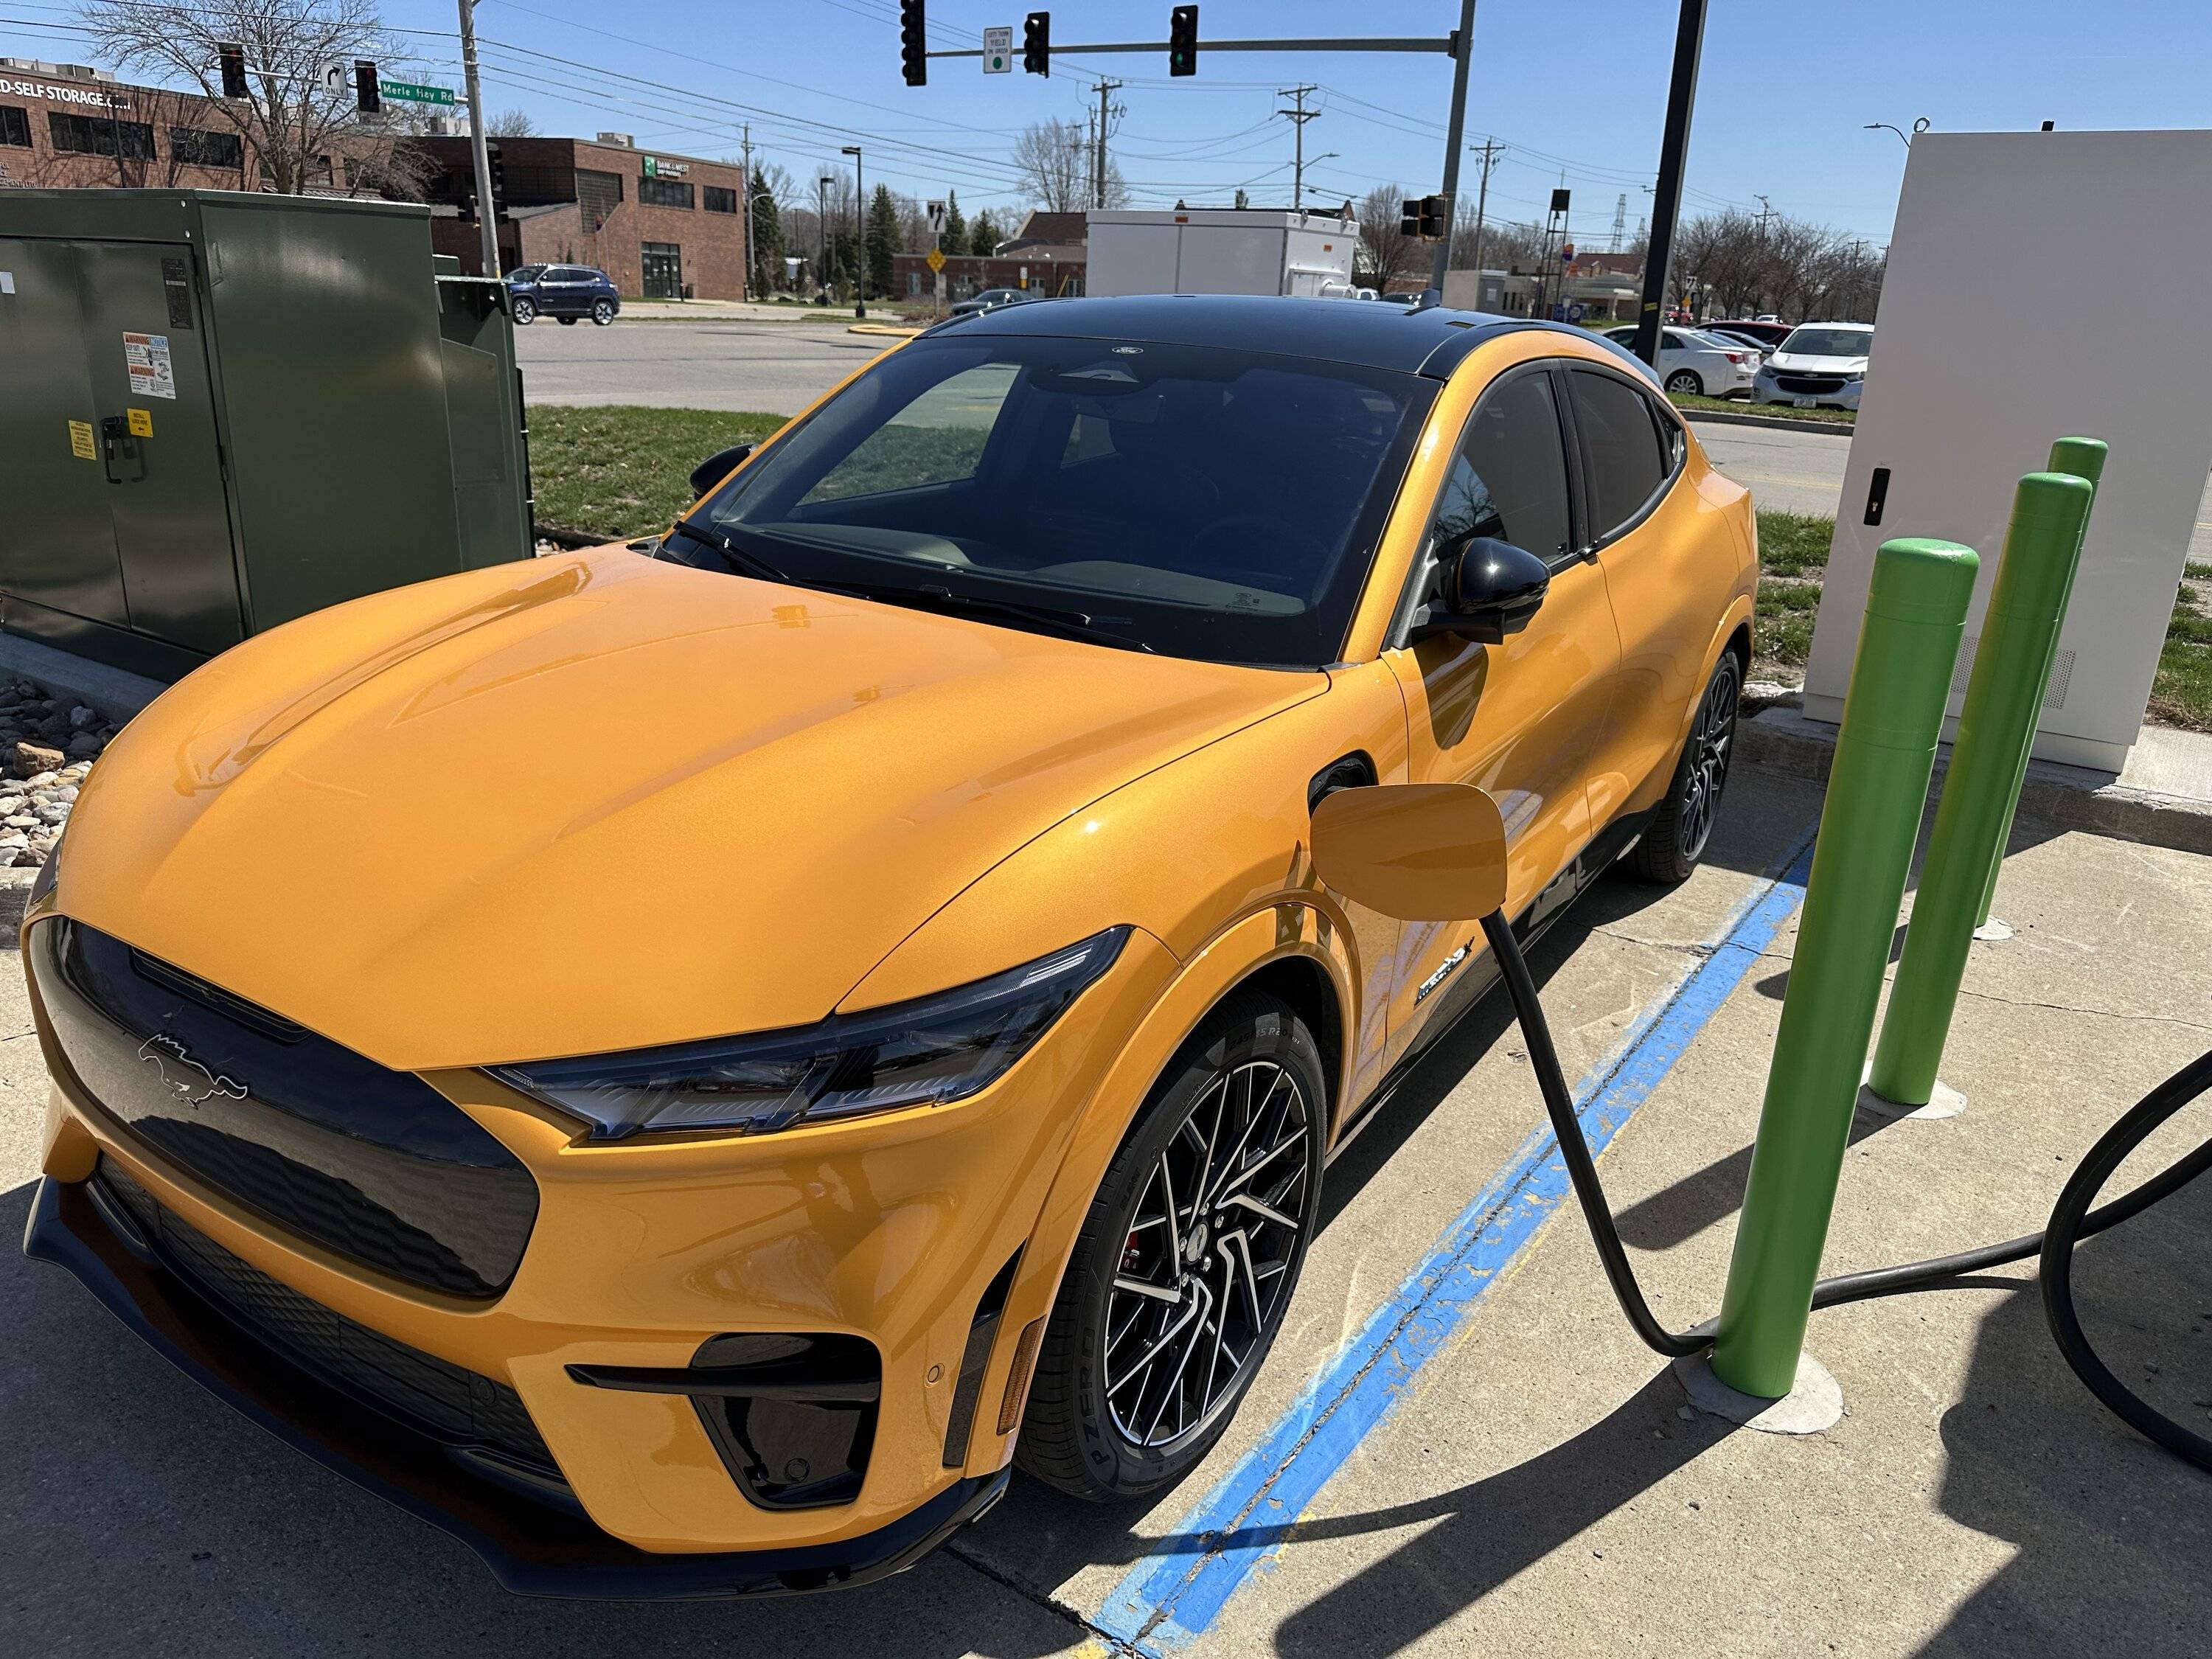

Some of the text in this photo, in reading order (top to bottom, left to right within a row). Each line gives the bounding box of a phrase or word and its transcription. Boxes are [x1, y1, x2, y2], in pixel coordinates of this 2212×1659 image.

[0, 79, 44, 97] D-SELF
[325, 86, 344, 96] ONLY
[383, 83, 453, 102] Merle Hay Rd
[1079, 1327, 1110, 1465] P ZERO
